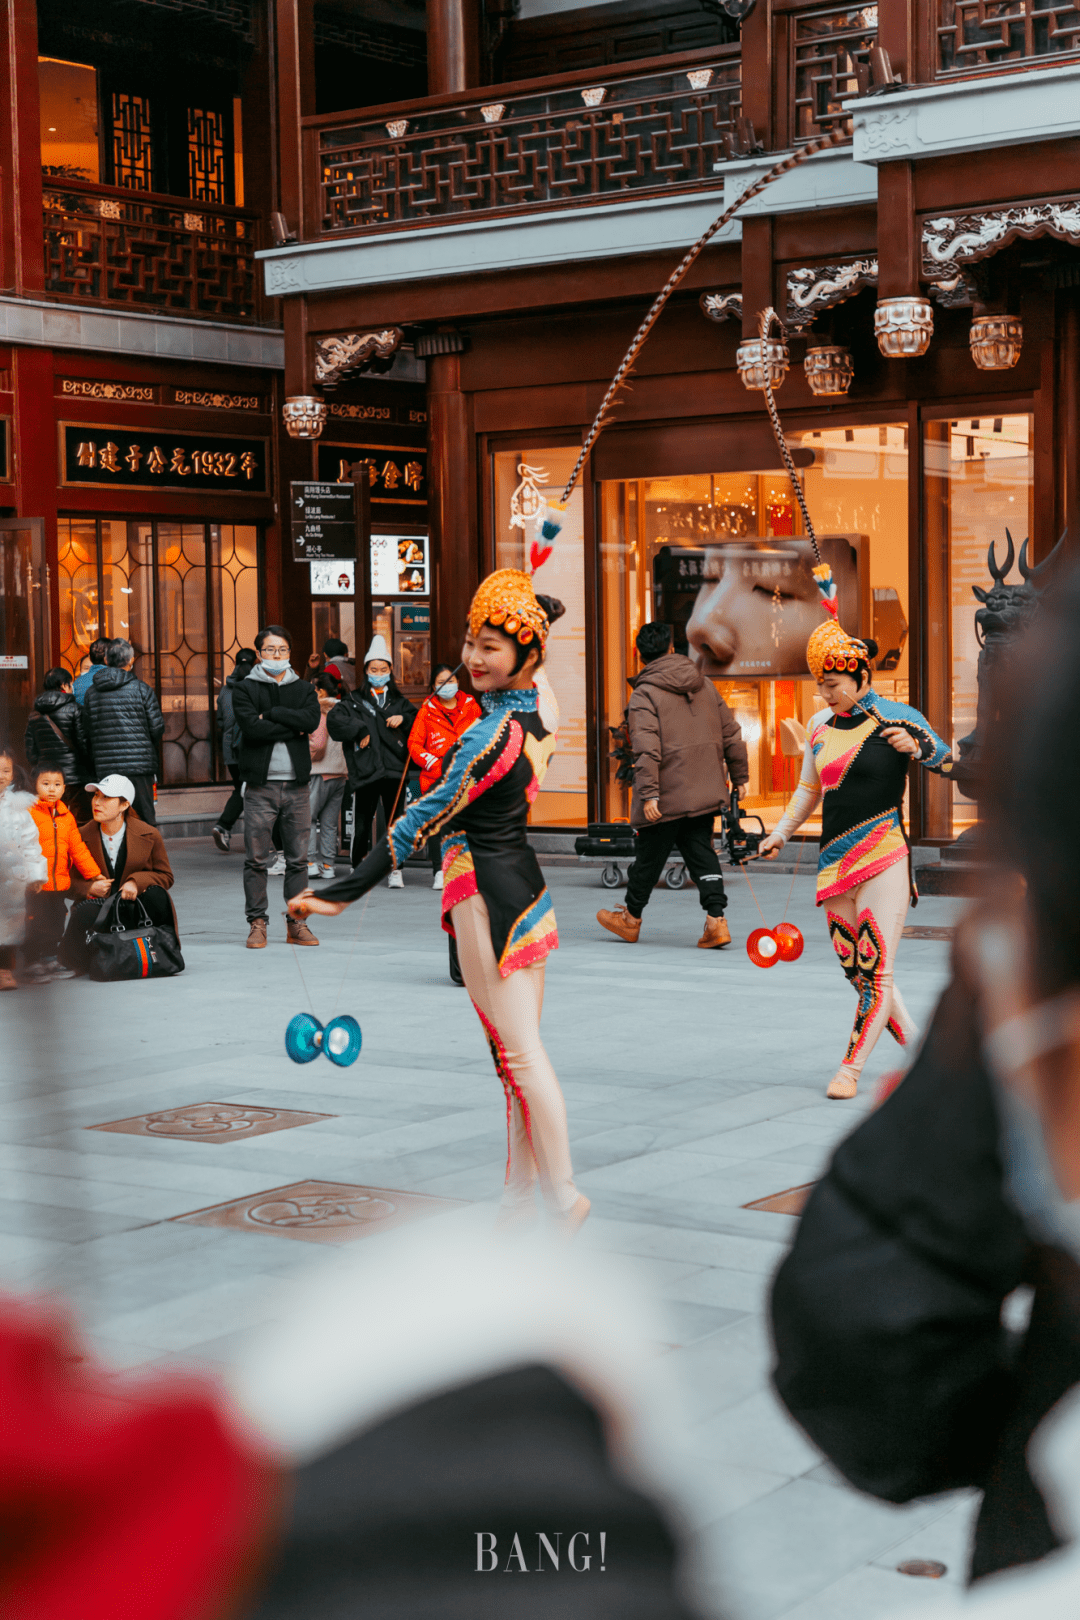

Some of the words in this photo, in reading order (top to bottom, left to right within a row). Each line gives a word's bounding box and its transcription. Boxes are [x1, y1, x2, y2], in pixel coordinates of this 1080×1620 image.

[77, 441, 259, 480] 创建于公元1932年
